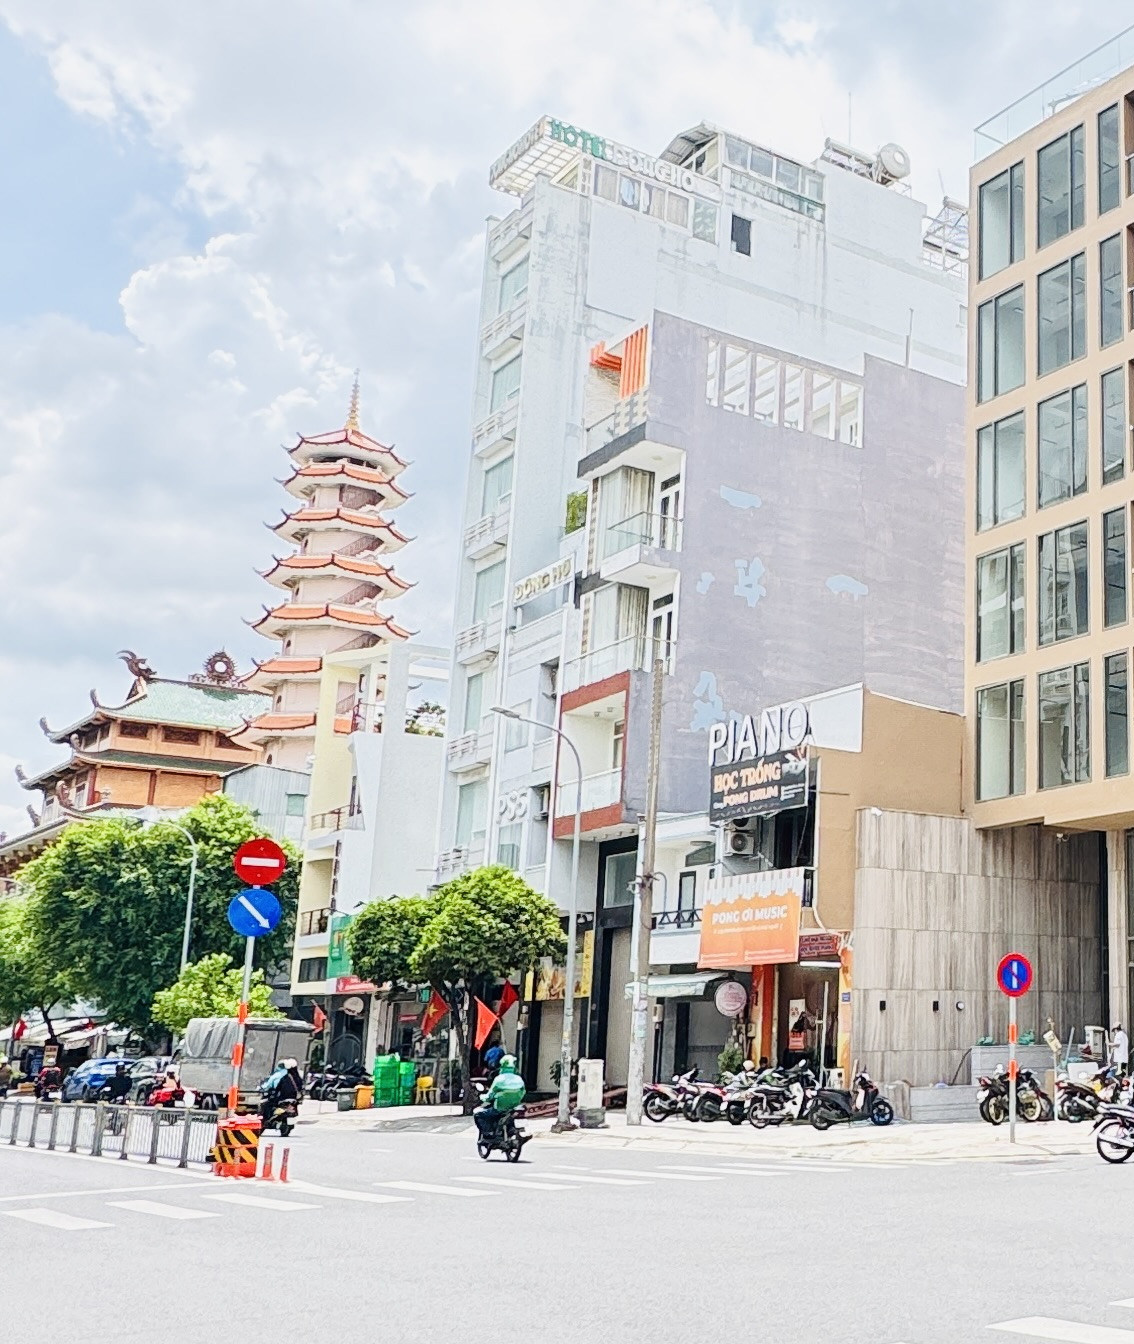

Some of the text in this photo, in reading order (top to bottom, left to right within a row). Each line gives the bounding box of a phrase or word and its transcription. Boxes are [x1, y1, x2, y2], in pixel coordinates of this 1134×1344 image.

[708, 702, 808, 767] PIANO
[714, 758, 781, 795] HỌC TRỐNG
[754, 905, 788, 921] MUSIC
